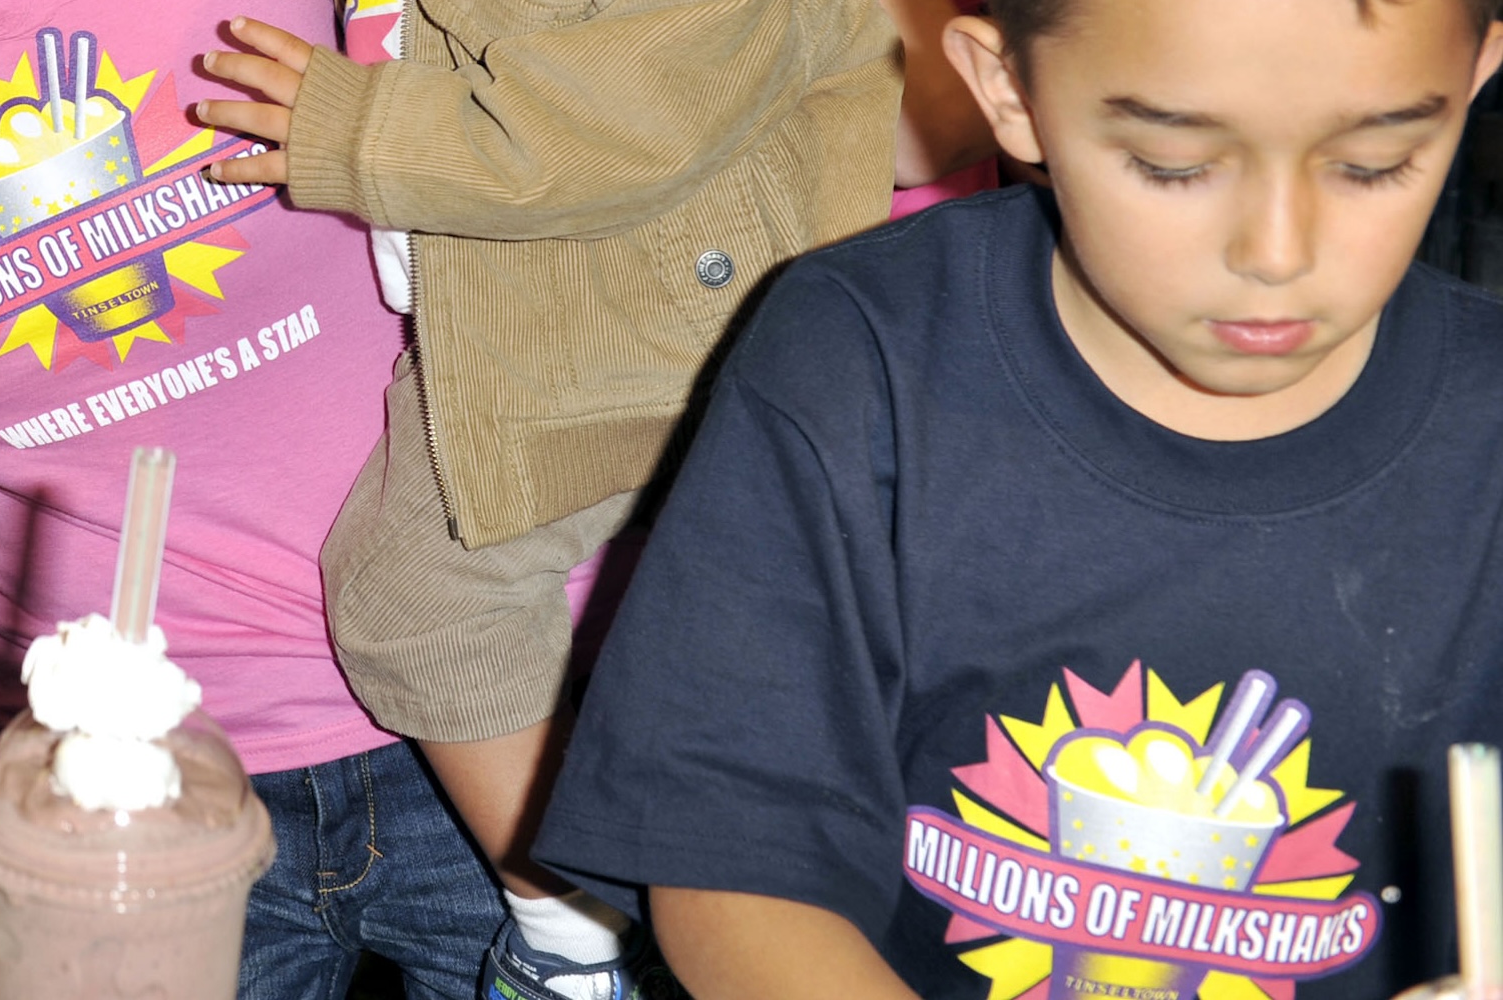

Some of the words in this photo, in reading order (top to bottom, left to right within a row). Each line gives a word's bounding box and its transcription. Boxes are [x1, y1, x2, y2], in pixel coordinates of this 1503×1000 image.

[38, 228, 85, 279] OF
[70, 280, 160, 320] TINSELTOWN
[85, 346, 238, 427] EVERYONE'S
[241, 336, 261, 371] A
[257, 304, 321, 362] STAR
[908, 820, 1080, 929] MILLIONS
[1085, 883, 1138, 938] OF
[1141, 896, 1368, 964] MILKSHAKES
[1065, 975, 1180, 1000] TINSELTOWN
